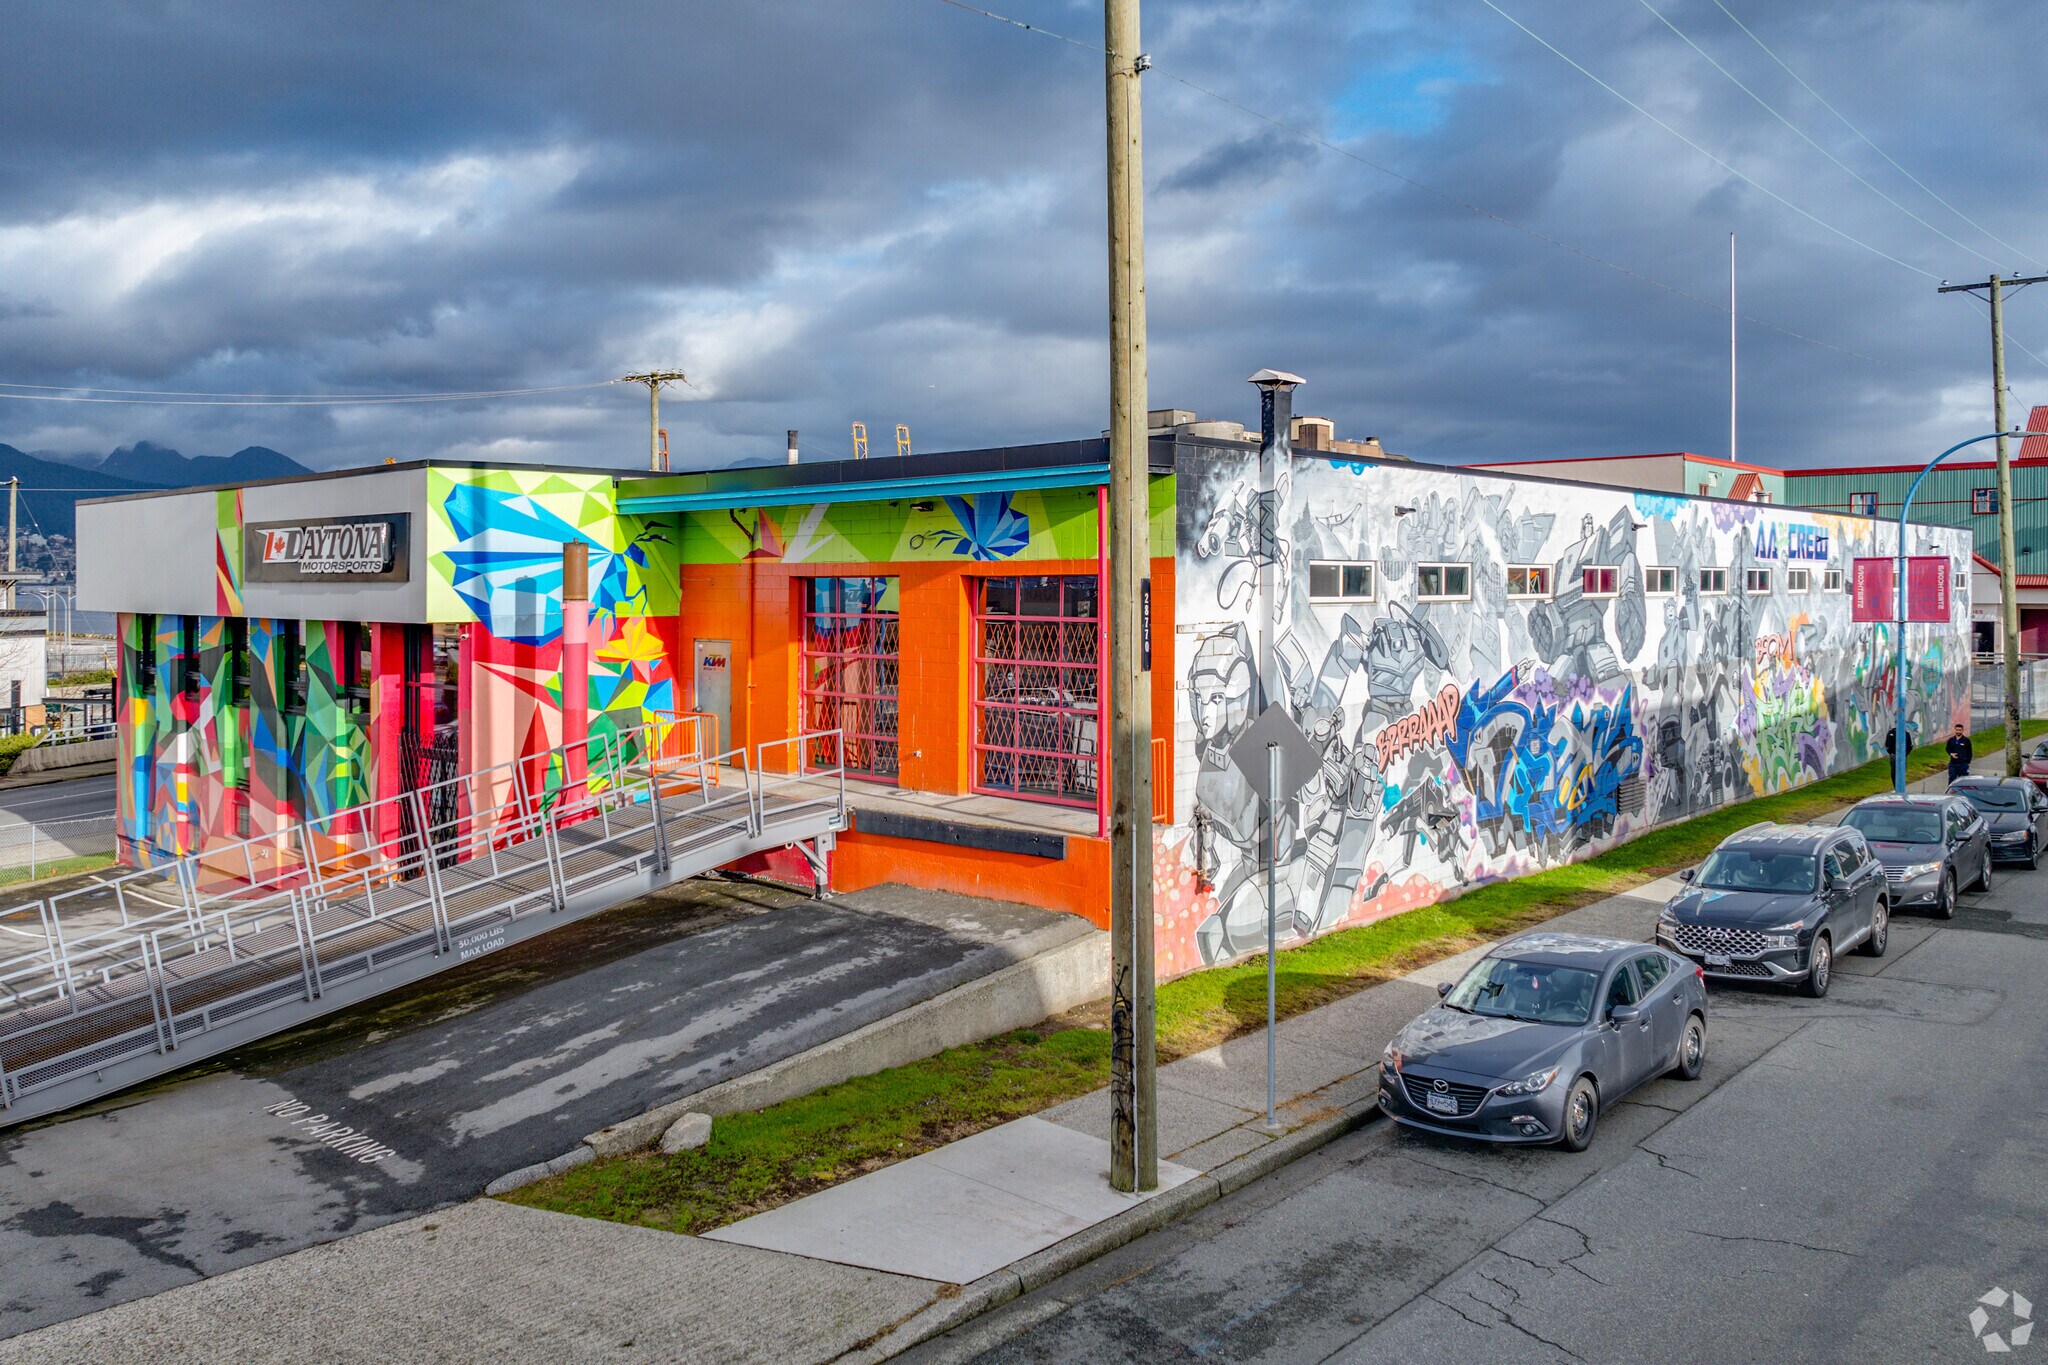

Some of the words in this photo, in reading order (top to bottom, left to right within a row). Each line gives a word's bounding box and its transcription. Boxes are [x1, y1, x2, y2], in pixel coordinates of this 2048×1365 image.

[285, 525, 382, 559] DAYTONA
[302, 560, 382, 571] MOTORSPORTS
[703, 654, 726, 668] KTM
[1376, 683, 1460, 774] BRRRAAAP
[460, 946, 481, 960] MAX
[483, 937, 505, 952] LOAD
[263, 1098, 311, 1118] NO
[291, 1113, 396, 1164] PARKING
